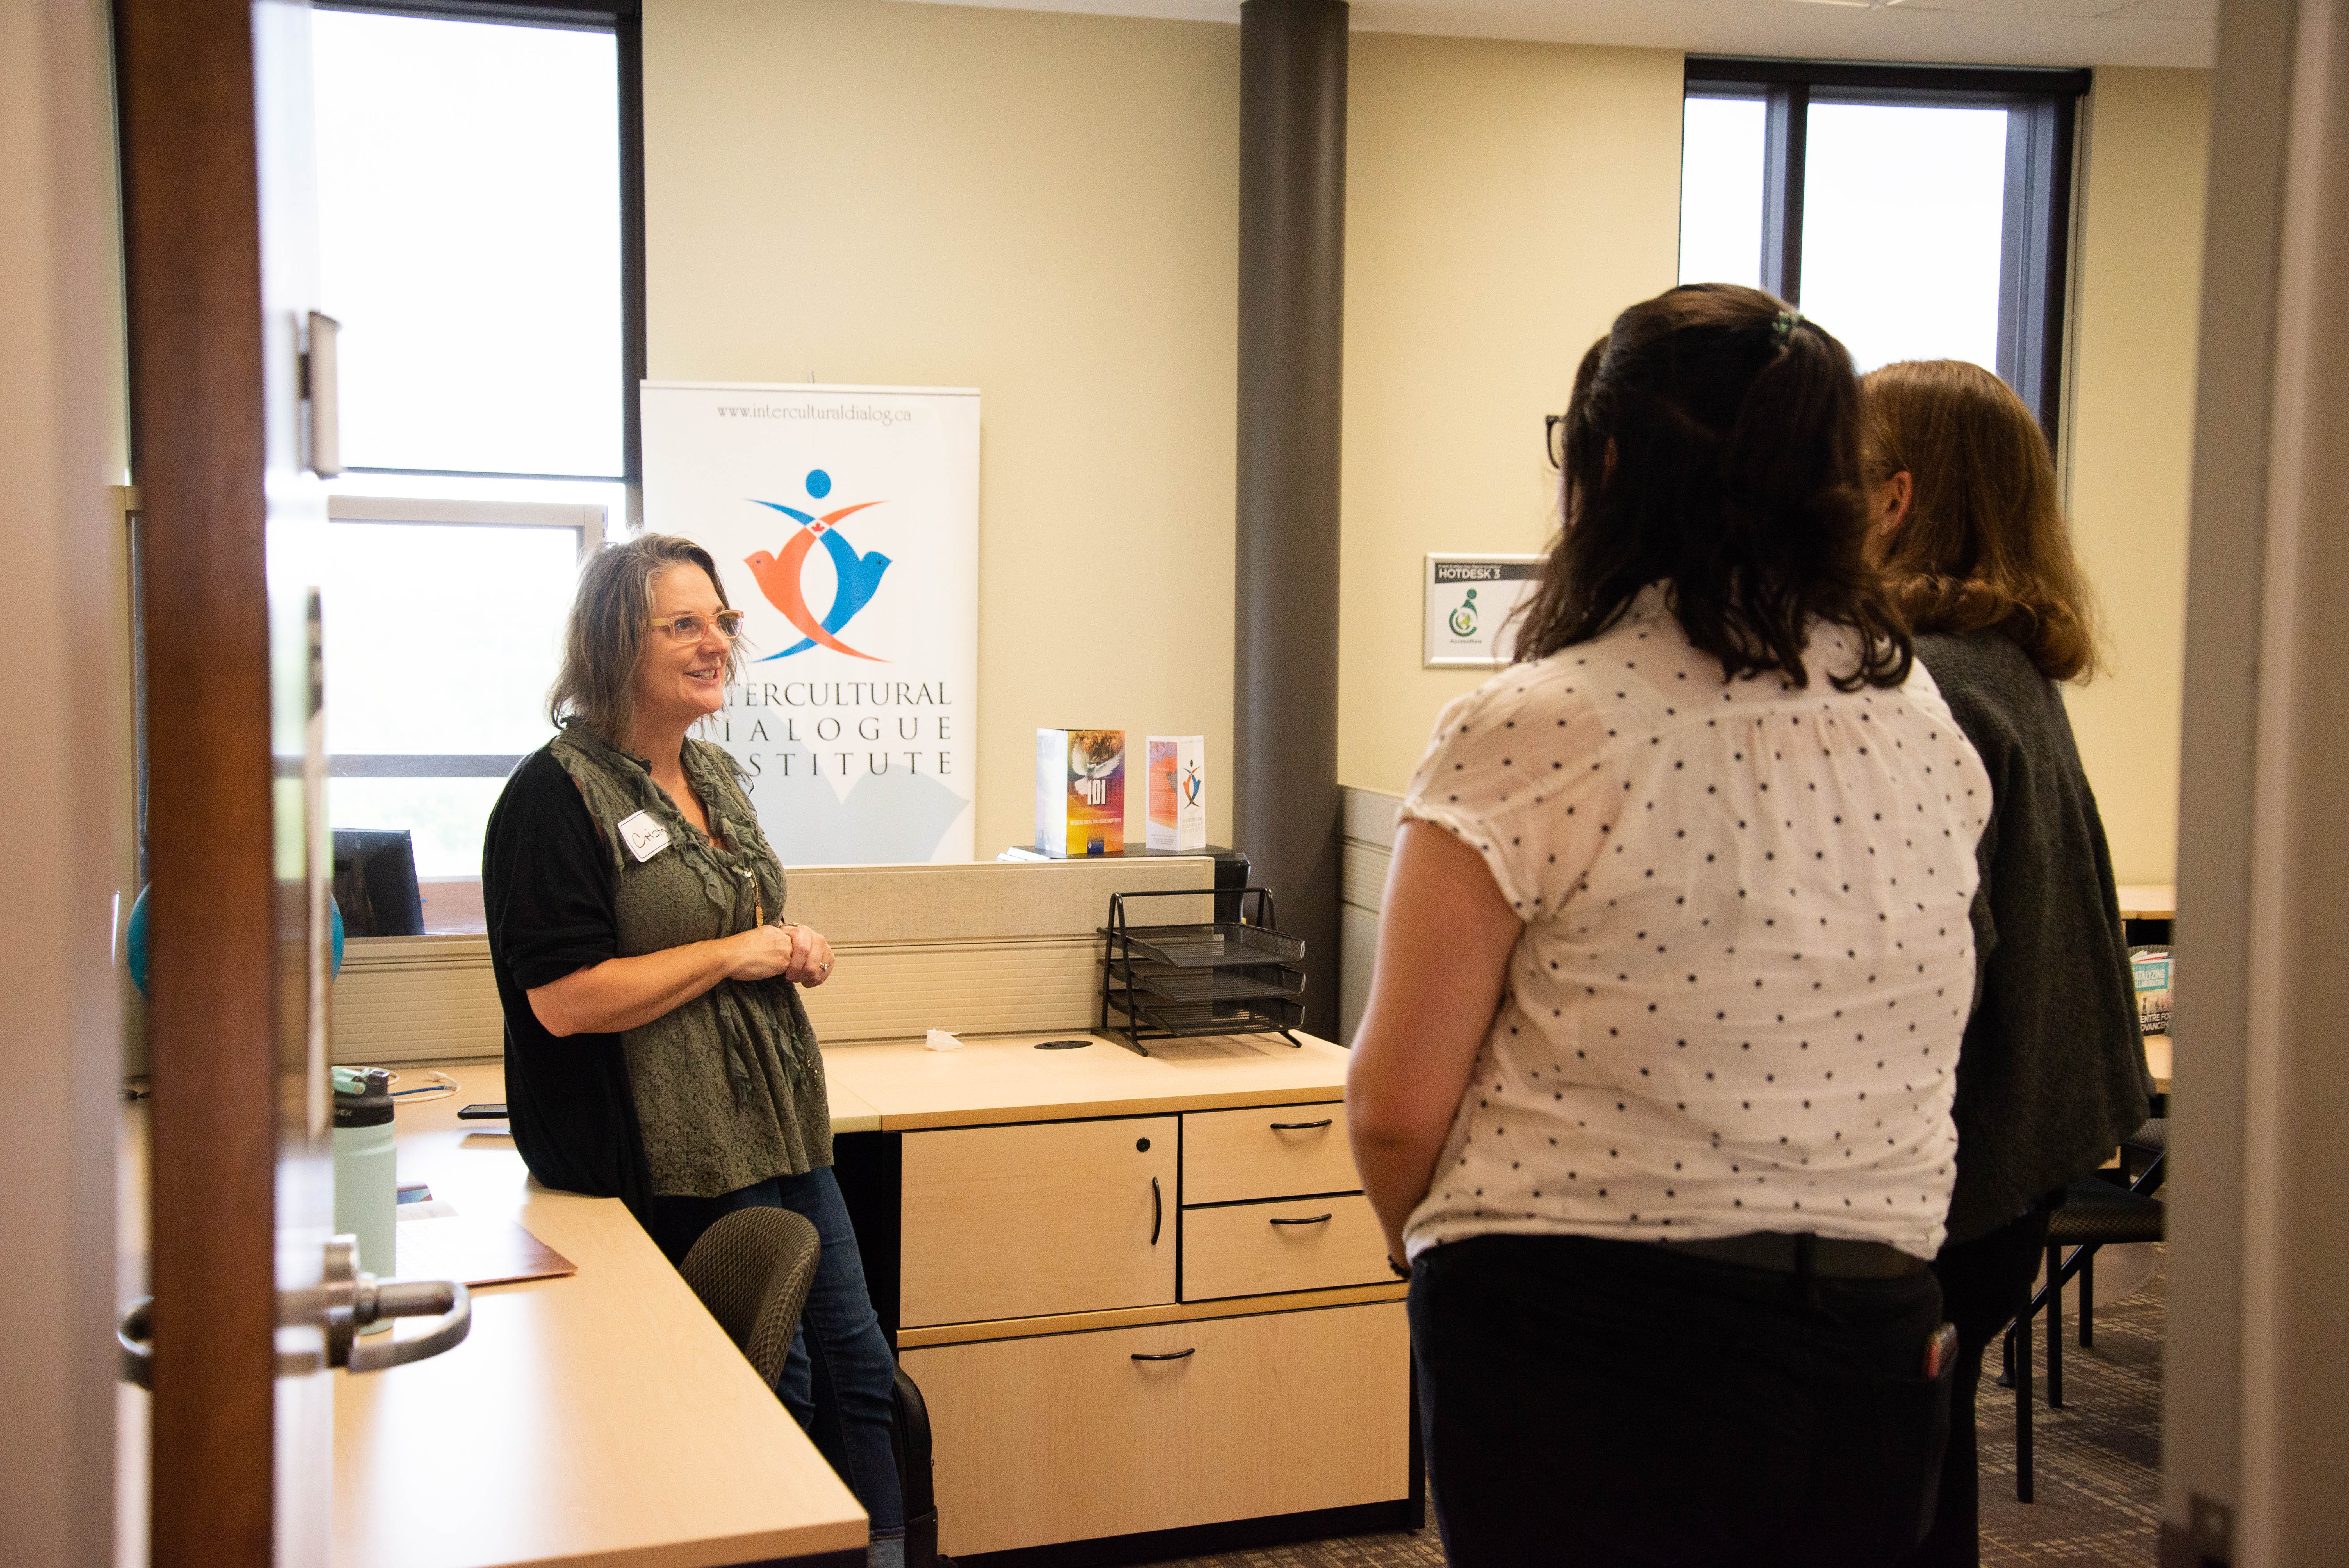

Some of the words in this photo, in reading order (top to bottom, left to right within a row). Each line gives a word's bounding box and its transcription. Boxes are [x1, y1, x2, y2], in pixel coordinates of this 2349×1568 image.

[717, 404, 912, 426] www.interculturaldialog.ca
[1439, 568, 1491, 579] HOTDESK
[1494, 568, 1501, 579] 3
[729, 682, 952, 706] TERCULTURAL
[726, 717, 950, 741] IALOGUE
[749, 751, 951, 777] STITUTE
[1087, 779, 1106, 805] IDI
[2133, 969, 2165, 980] ATALYZING
[2140, 1014, 2160, 1023] ENTRE
